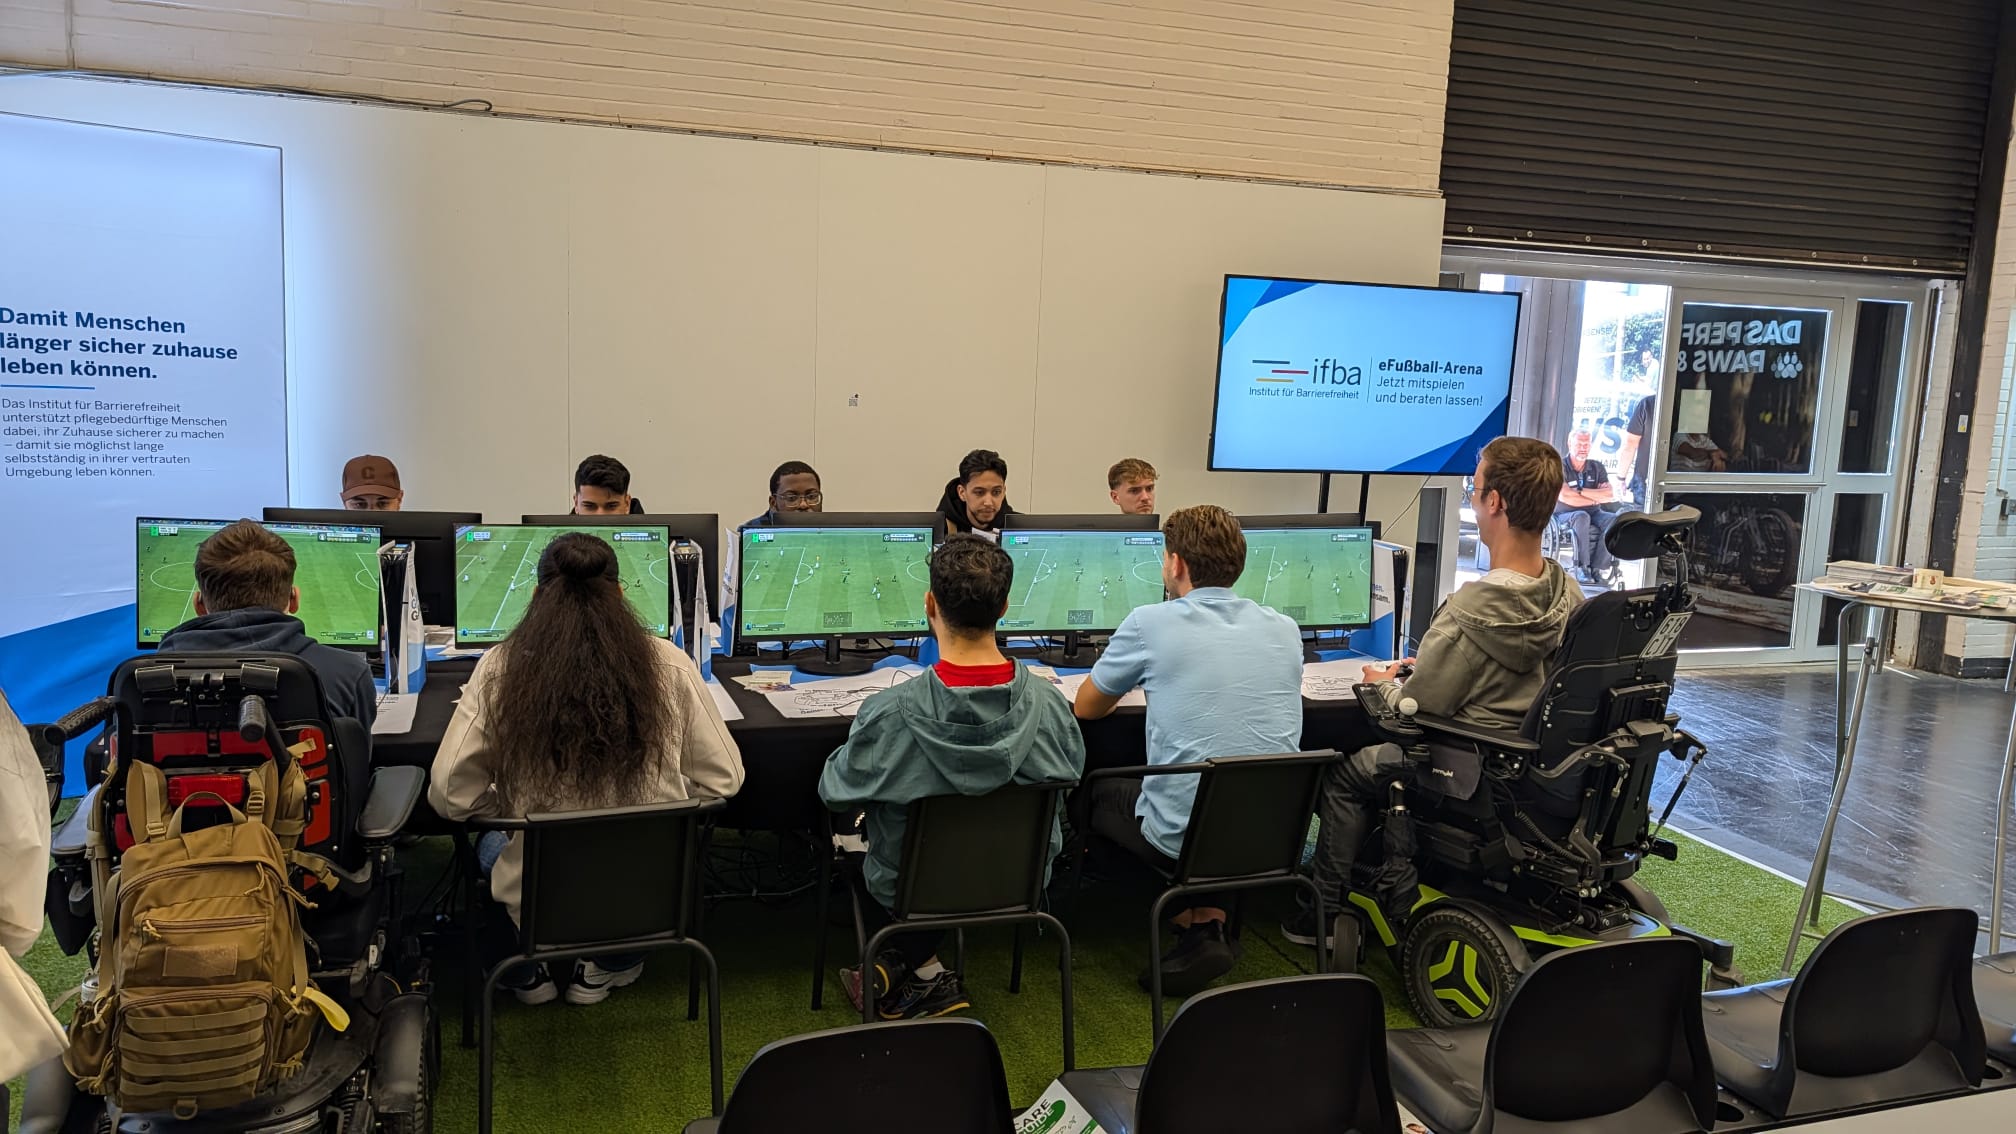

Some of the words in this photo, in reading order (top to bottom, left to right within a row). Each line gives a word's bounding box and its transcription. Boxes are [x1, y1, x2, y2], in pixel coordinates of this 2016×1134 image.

[0, 307, 68, 327] Damit
[75, 311, 186, 334] Menschen
[0, 332, 72, 353] länger
[78, 337, 146, 355] sicher
[152, 341, 238, 359] zuhause
[0, 357, 64, 375] leben
[70, 360, 157, 379] können.
[1312, 358, 1362, 386] ifba
[1378, 359, 1483, 376] eFußball-Arena
[1376, 376, 1405, 389] Jetzt
[1408, 377, 1465, 392] mitspielen
[1249, 386, 1279, 398] Institut
[1281, 387, 1294, 399] für
[1296, 387, 1360, 400] Barrierefreiheit
[1375, 392, 1397, 404] und
[1399, 393, 1442, 406] beraten
[1445, 394, 1483, 407] lassen!
[2, 399, 26, 409] Das
[28, 399, 72, 410] Institut
[74, 399, 91, 410] für
[94, 400, 181, 412] Barrierefreiheit
[2, 413, 71, 423] unterstützt
[74, 414, 168, 426] pflegebedürftige
[171, 416, 227, 427] Menschen
[3, 427, 40, 438] dabei,
[44, 427, 59, 437] ihr
[62, 427, 113, 438] Zuhause
[116, 428, 163, 439] sicherer
[165, 430, 178, 439] zu
[181, 429, 225, 439] machen
[16, 440, 51, 450] damit
[54, 441, 71, 451] sie
[74, 441, 131, 453] möglichst
[134, 441, 164, 453] lange
[5, 453, 86, 465] selbstständig
[89, 453, 99, 464] in
[102, 453, 129, 464] ihrer
[131, 454, 190, 465] vertrauten
[5, 467, 73, 479] Umgebung
[75, 467, 108, 477] leben
[110, 467, 156, 478] können.
